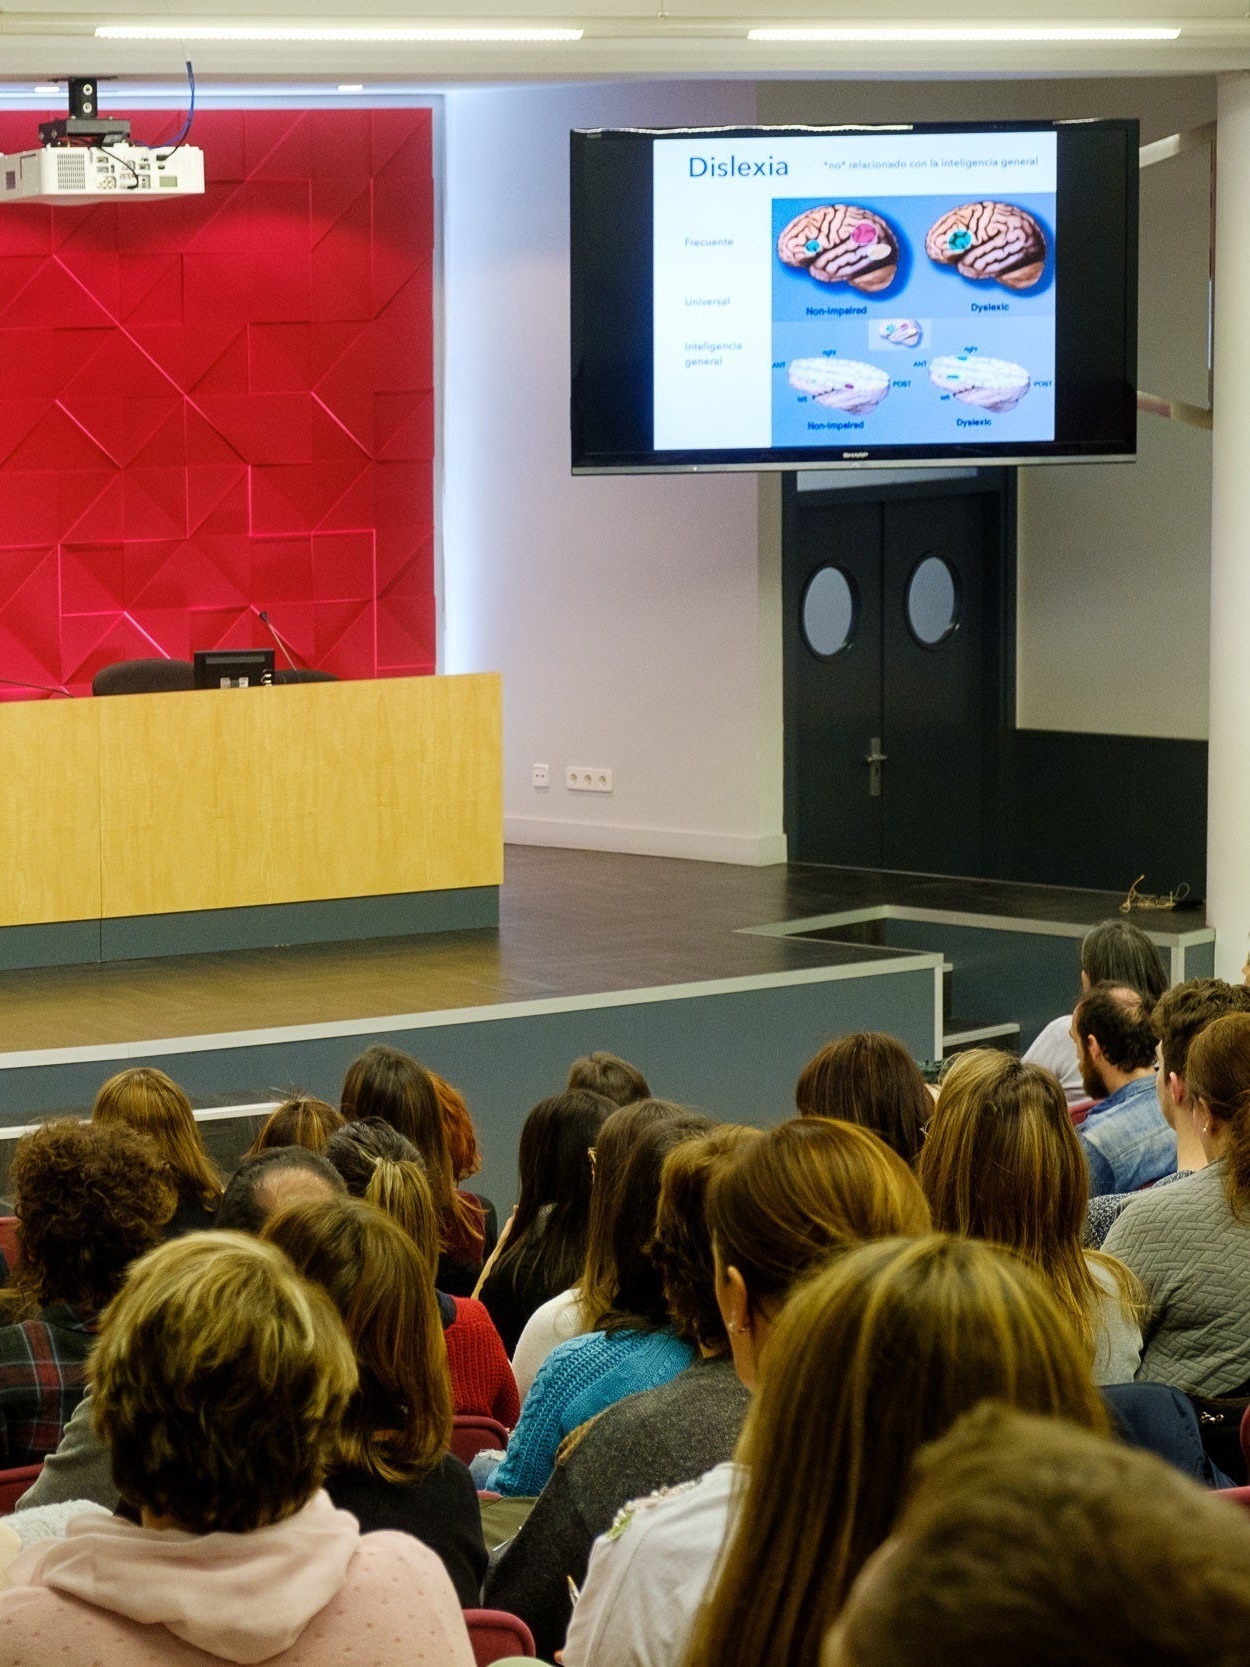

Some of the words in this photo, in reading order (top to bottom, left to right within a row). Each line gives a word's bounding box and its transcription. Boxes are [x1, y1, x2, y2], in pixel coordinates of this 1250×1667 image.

[689, 154, 788, 178] Dislexia
[850, 158, 907, 168] relacionado
[909, 159, 927, 168] con
[930, 157, 938, 168] la
[941, 156, 998, 170] inteligencia
[1001, 155, 1038, 169] general
[684, 237, 734, 247] Frecuente
[684, 296, 731, 306] Universal
[971, 303, 1009, 314] Dyslexic
[684, 340, 742, 353] Inteligencia
[684, 355, 723, 368] general
[956, 418, 992, 428] Dyslexic
